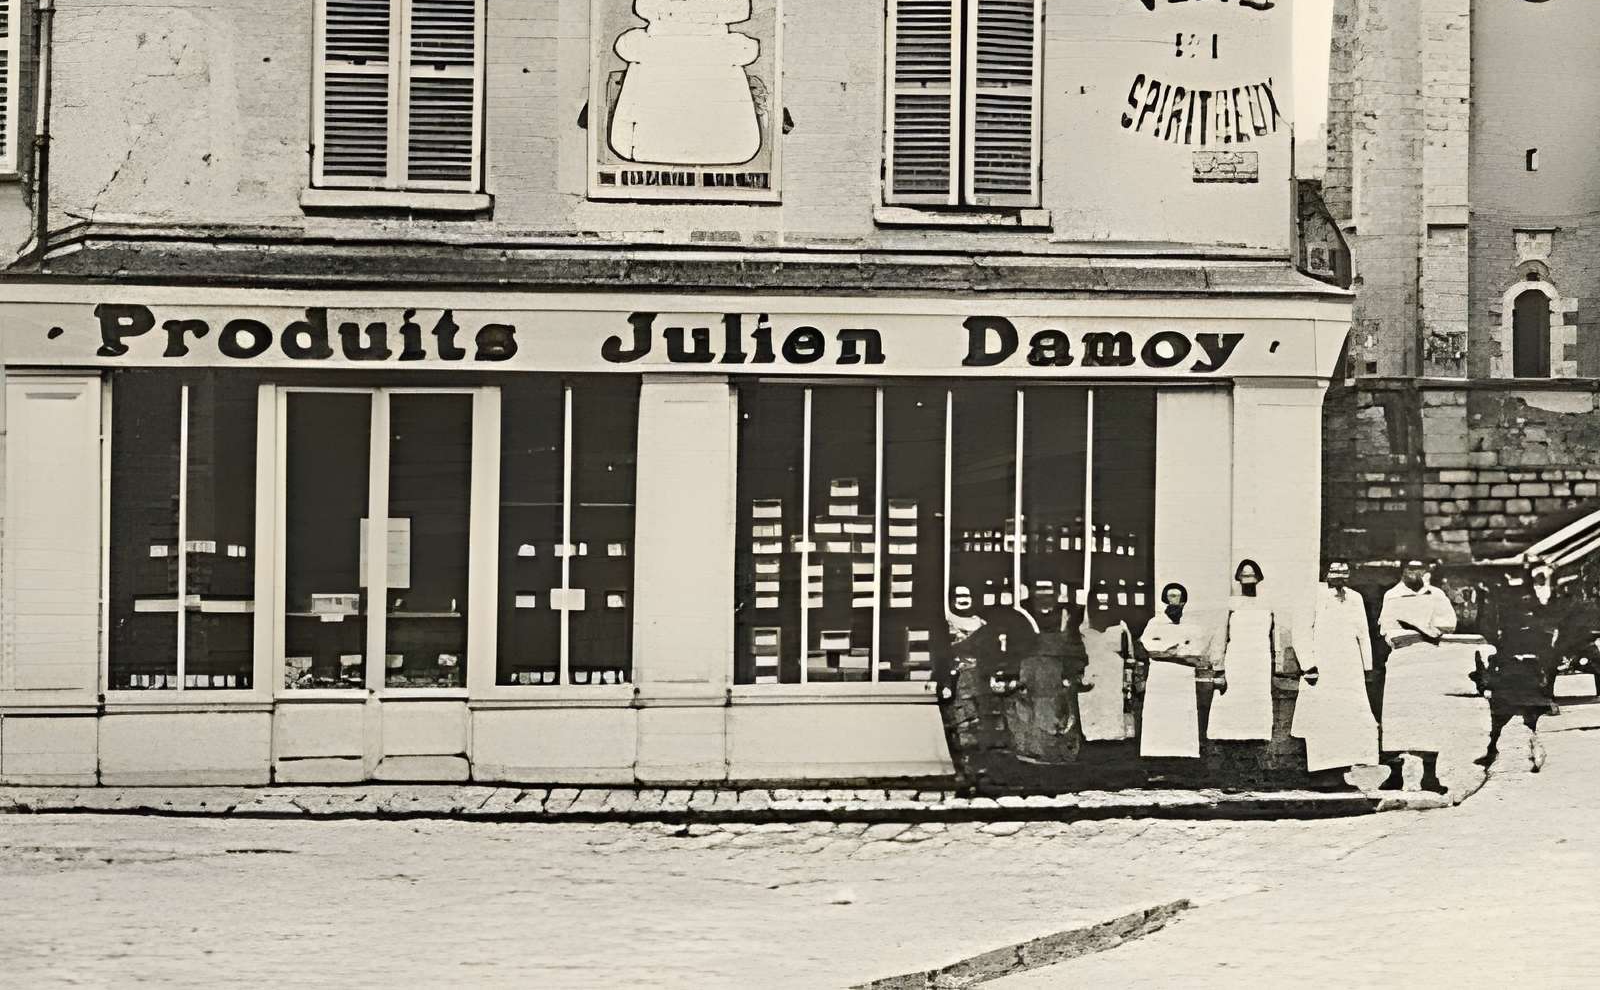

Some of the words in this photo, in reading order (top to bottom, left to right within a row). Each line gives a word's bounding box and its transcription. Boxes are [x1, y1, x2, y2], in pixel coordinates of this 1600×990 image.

[94, 302, 518, 362] Produits
[600, 311, 886, 365] Julien
[961, 315, 1245, 373] Damoy
